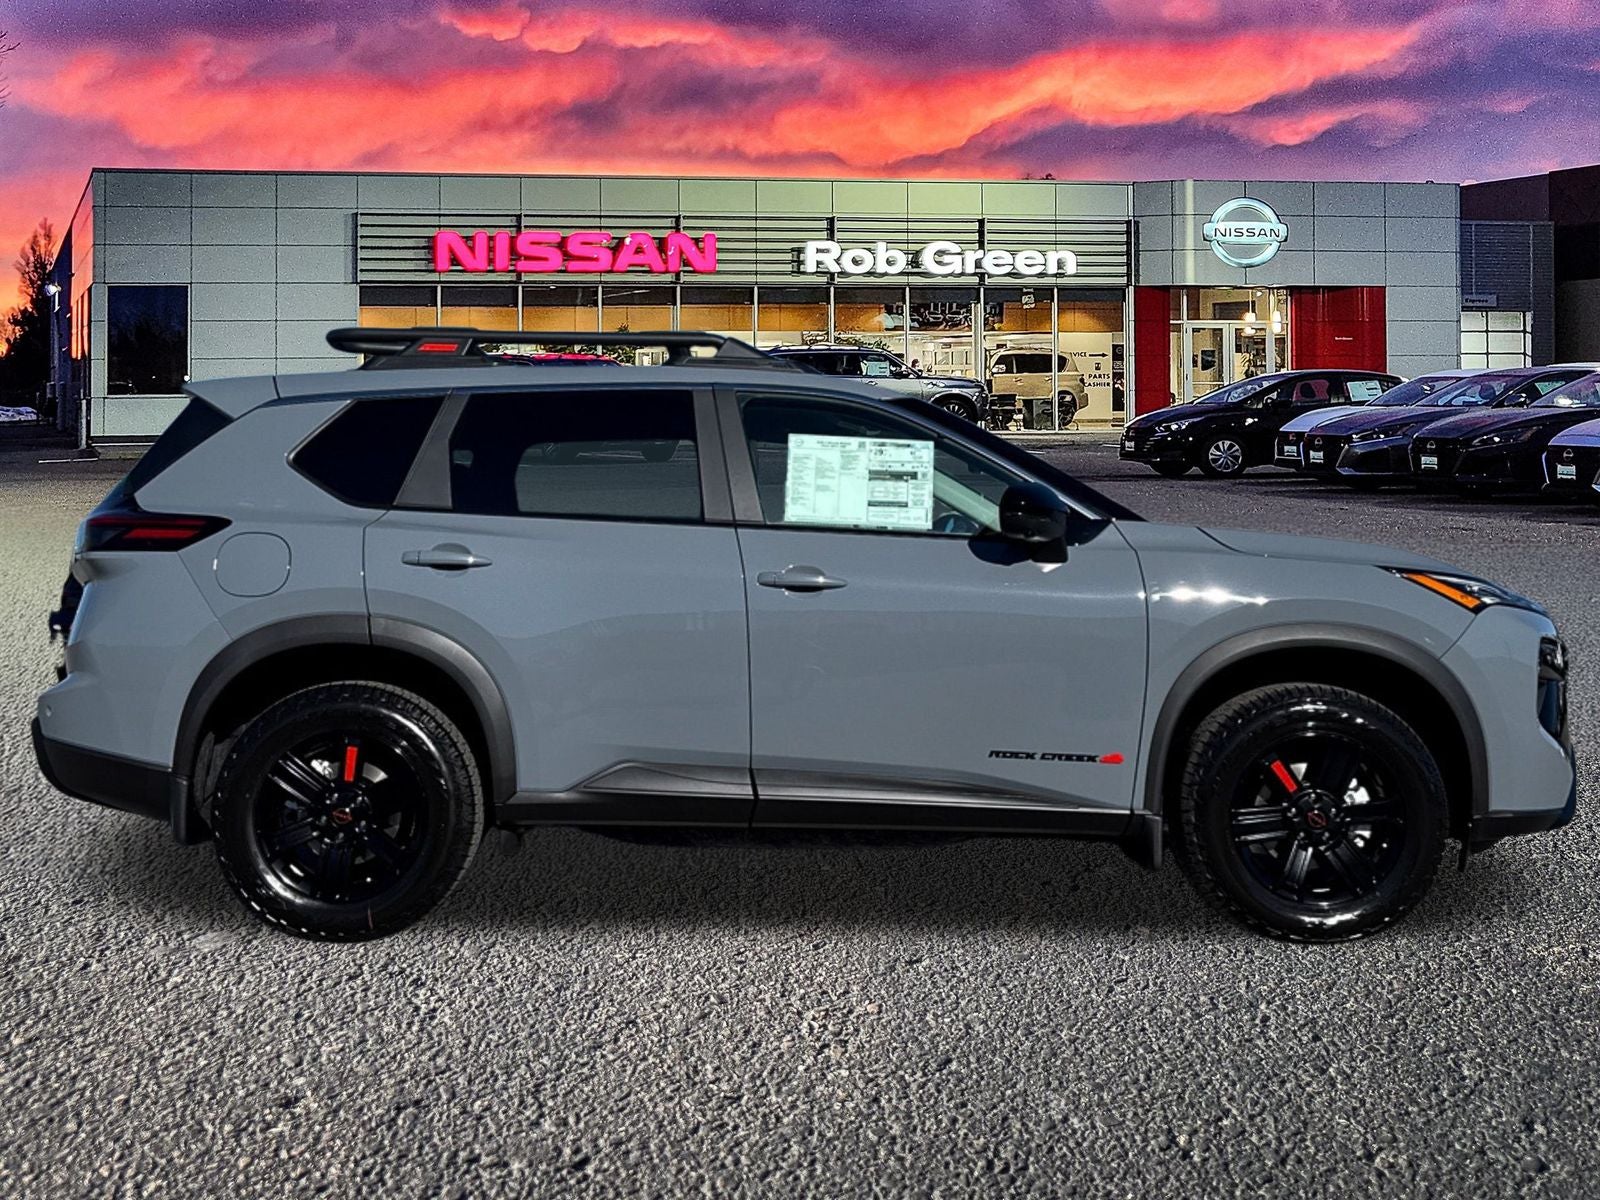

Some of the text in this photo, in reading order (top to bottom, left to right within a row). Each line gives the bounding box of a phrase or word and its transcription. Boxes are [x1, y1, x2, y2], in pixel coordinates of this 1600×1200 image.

[1214, 227, 1280, 238] NISSAN
[434, 230, 717, 273] NISSAN
[805, 240, 1078, 275] Rob Green
[988, 750, 1099, 763] ROCK CREEK
